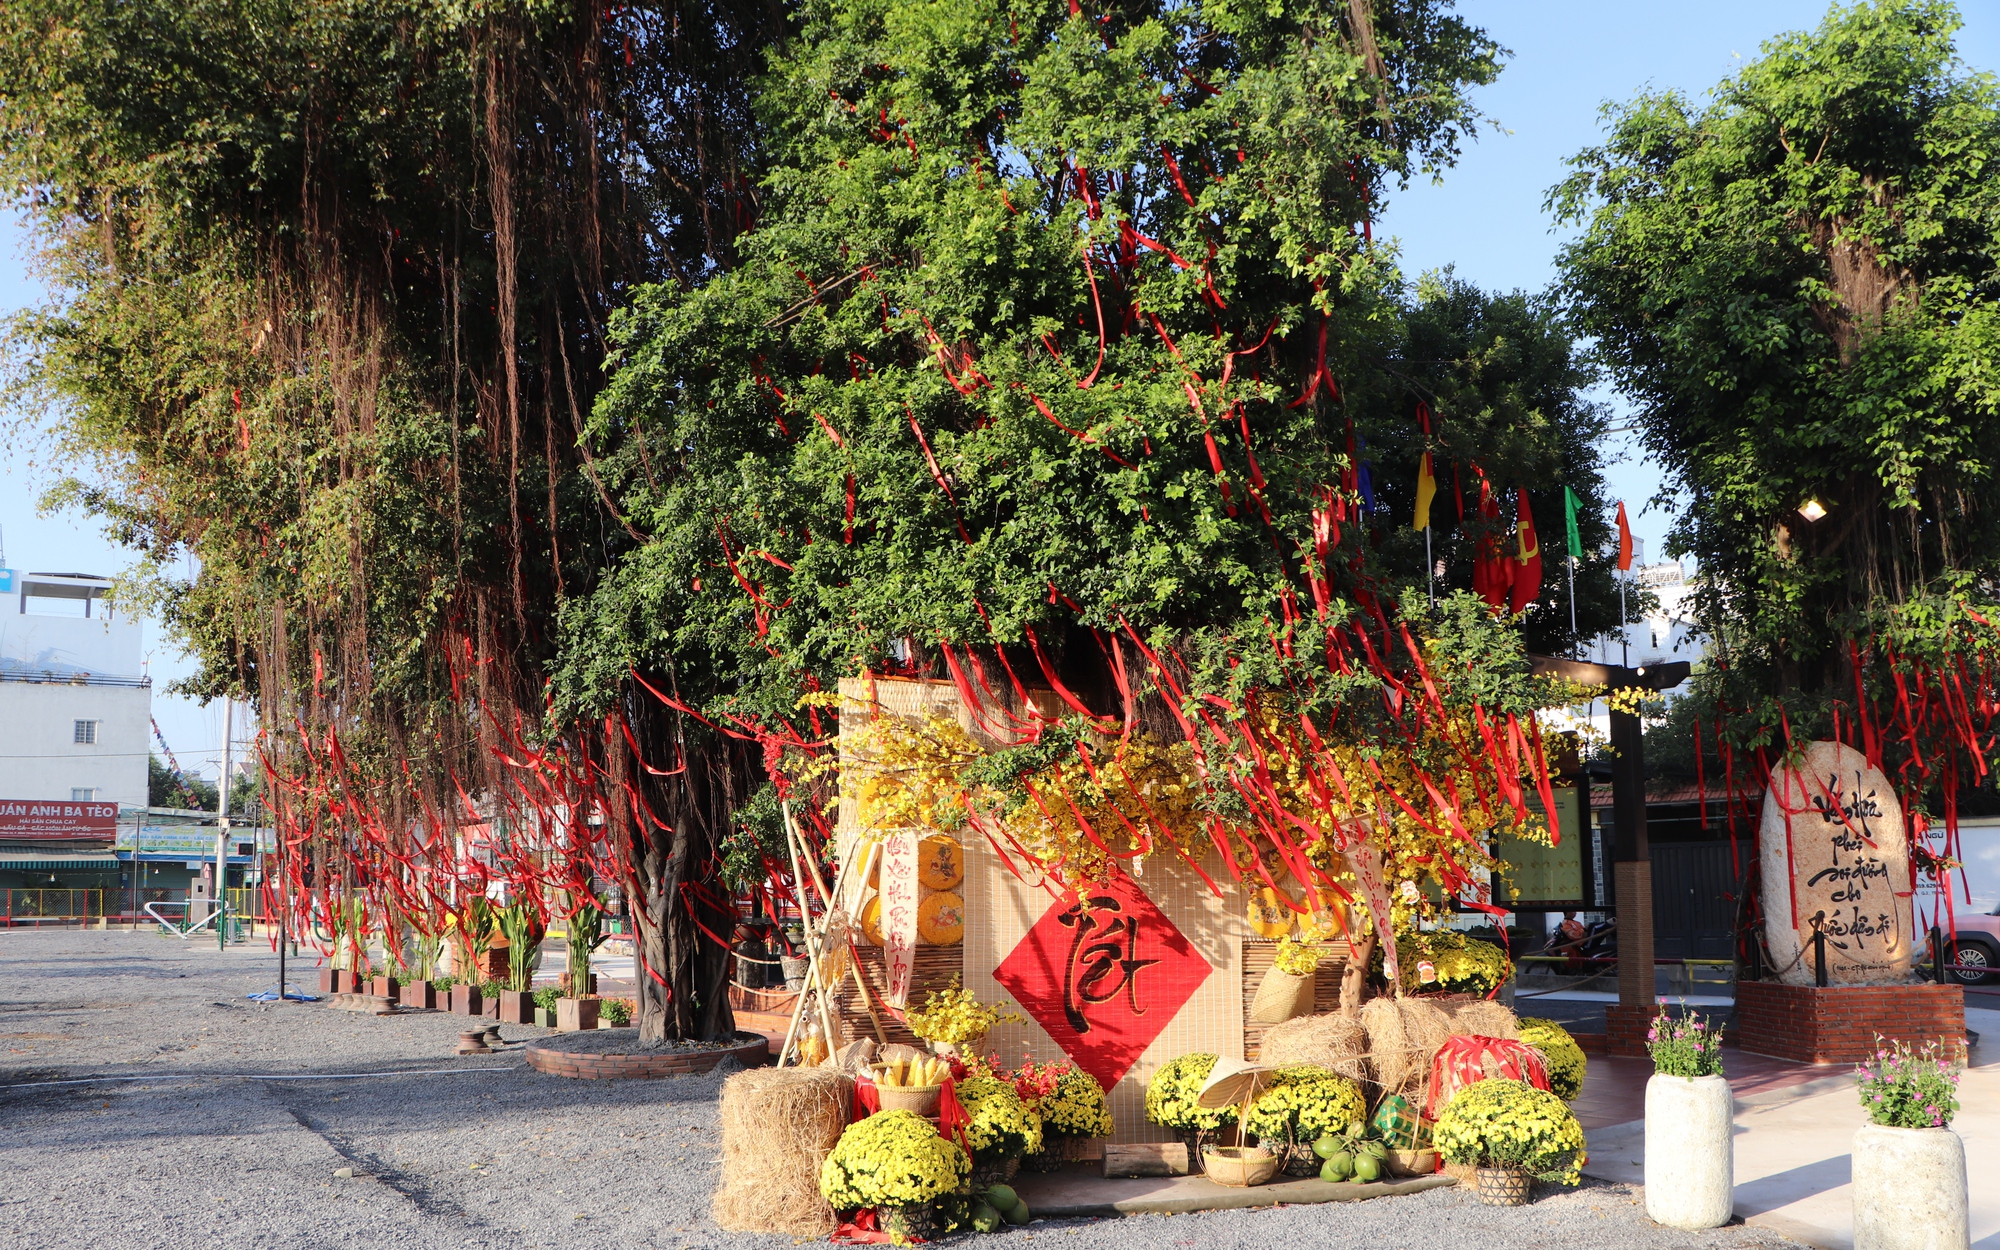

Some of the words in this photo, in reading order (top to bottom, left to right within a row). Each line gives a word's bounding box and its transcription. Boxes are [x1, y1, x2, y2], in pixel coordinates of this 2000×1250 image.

[30, 805, 60, 816] ANH
[64, 806, 83, 817] BA
[86, 804, 114, 818] TÈO
[1831, 881, 1861, 902] cho
